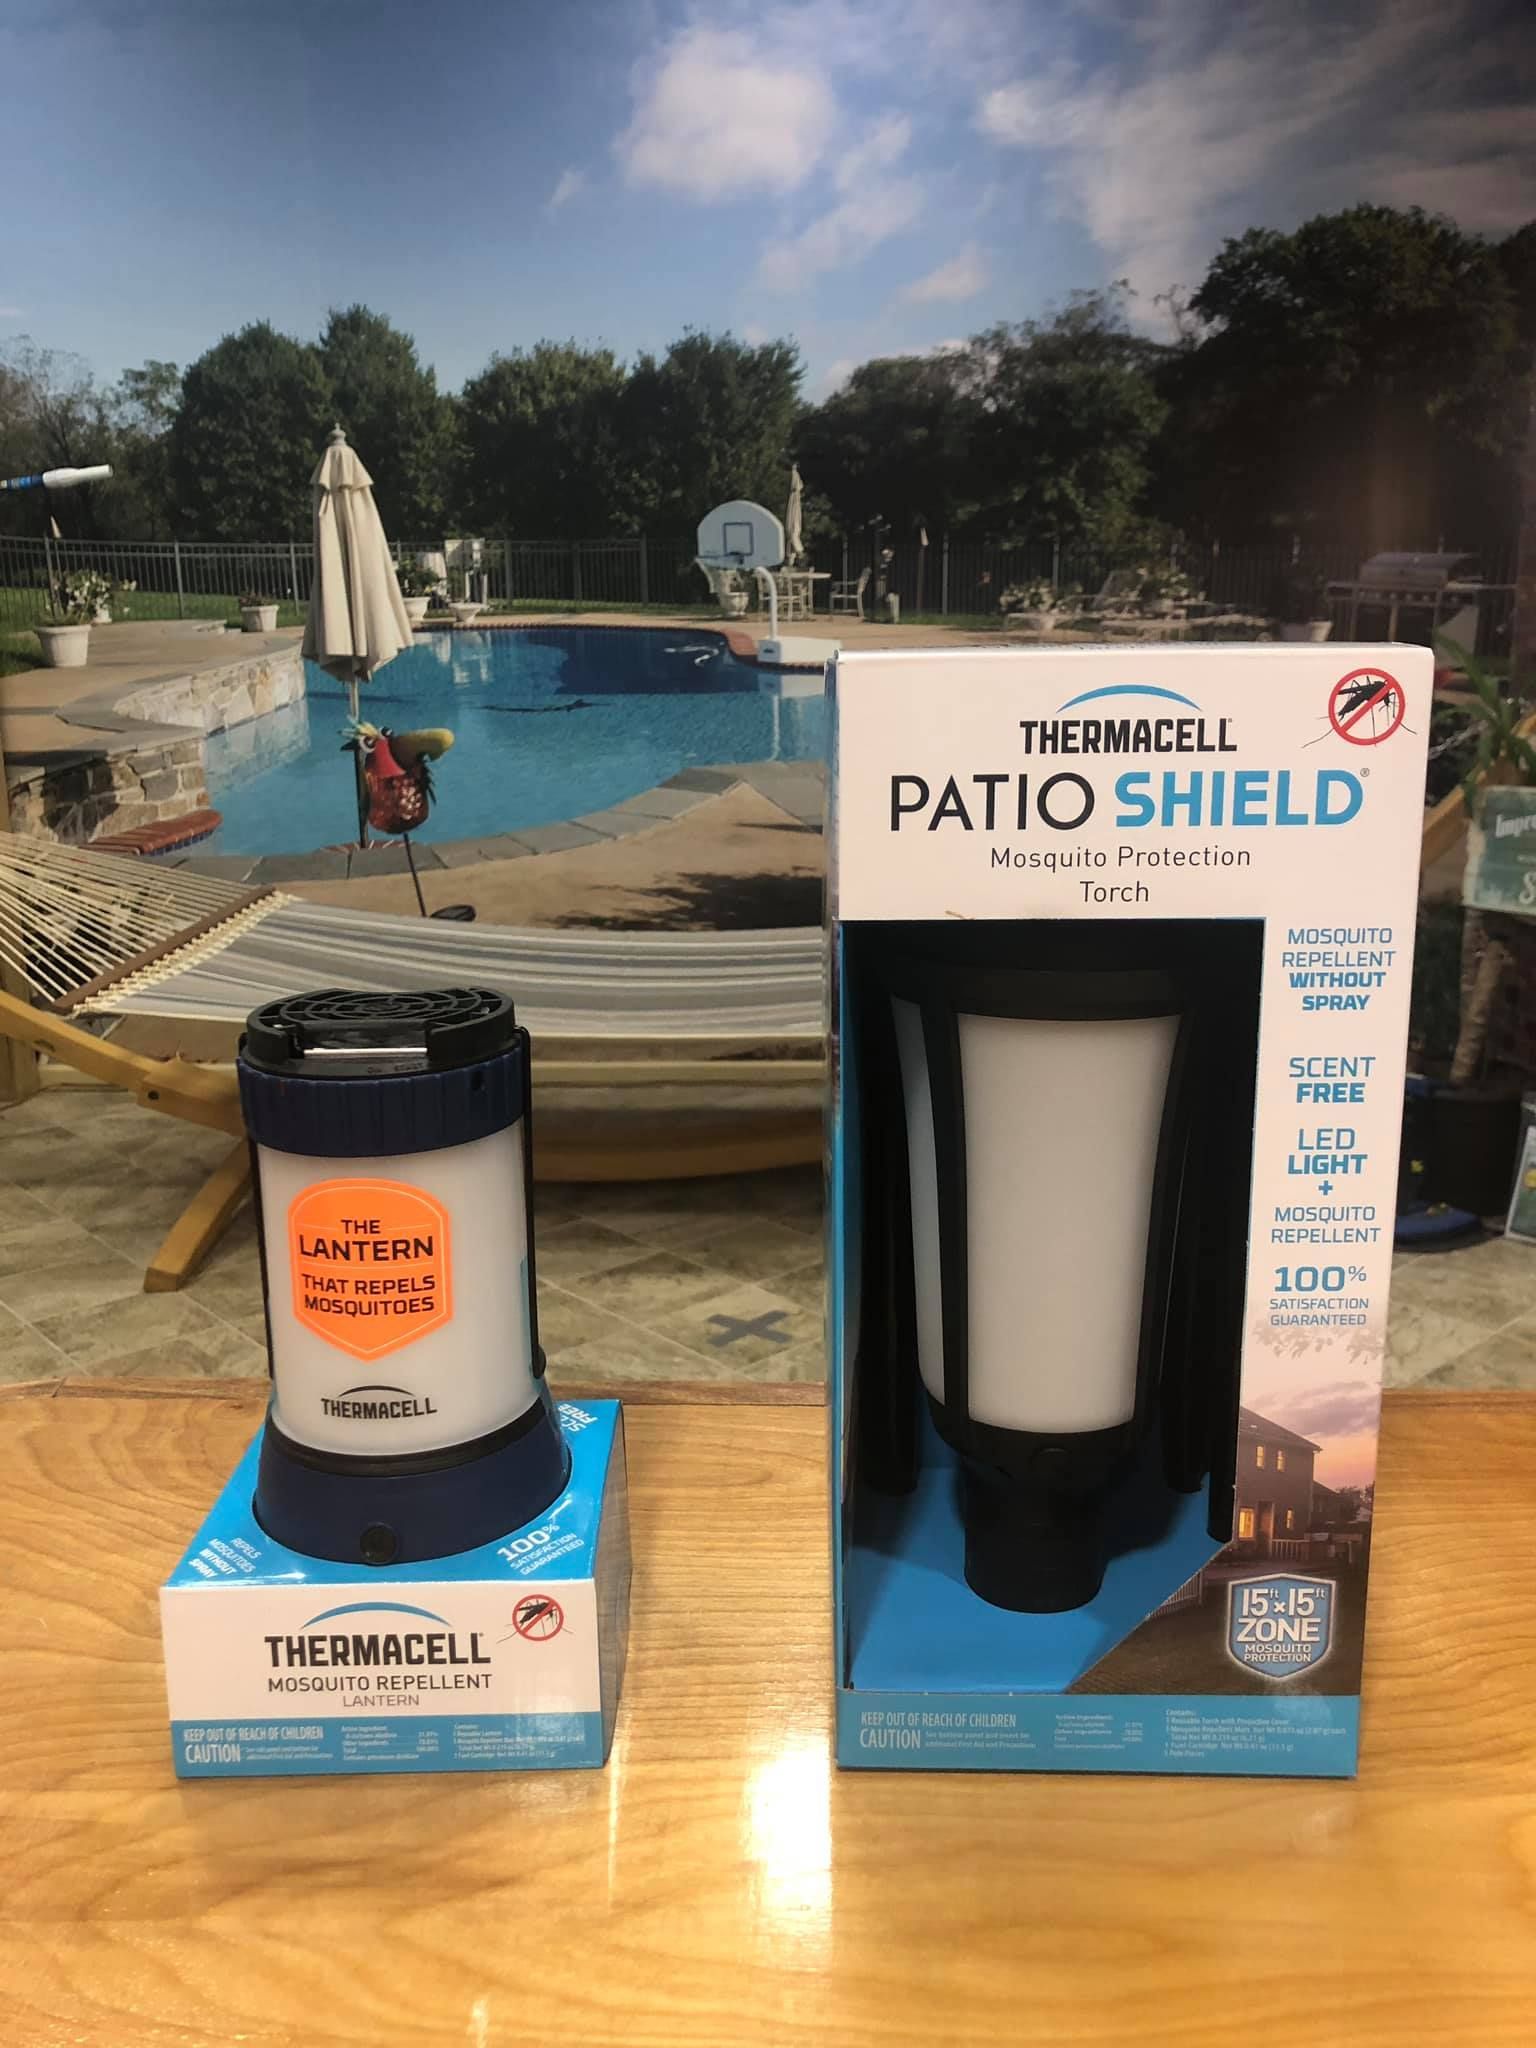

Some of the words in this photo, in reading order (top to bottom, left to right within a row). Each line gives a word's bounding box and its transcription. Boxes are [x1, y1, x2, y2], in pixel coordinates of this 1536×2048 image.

[1020, 718, 1237, 753] THERMACELL
[891, 772, 1095, 831] PATIO
[991, 847, 1106, 871] Mosquito
[1117, 846, 1250, 868] Protection
[1080, 881, 1149, 902] Torch
[1288, 928, 1393, 945] MOSQUITO
[1282, 951, 1396, 967] REPELLENT
[1289, 972, 1386, 988] WITHOUT
[1302, 995, 1370, 1010] SPRAY
[1289, 1057, 1376, 1078] SCENT
[1296, 1083, 1365, 1103] FREE
[1299, 1128, 1354, 1150] LED
[1288, 1155, 1368, 1174] LIGHT
[1275, 1207, 1375, 1222] MOSQUITO
[341, 1219, 381, 1234] THE
[1271, 1228, 1381, 1243] REPELLENT
[300, 1235, 434, 1261] LANTERN
[301, 1273, 349, 1294] THAT
[355, 1275, 436, 1295] REPELS
[1274, 1266, 1367, 1292] 100%
[305, 1295, 435, 1318] MOSQUITOES
[1270, 1298, 1369, 1309] SATISFACTION
[1271, 1314, 1366, 1326] GUARANTEED
[321, 1397, 438, 1419] THERMACELL
[497, 1524, 560, 1562] 100%
[520, 1539, 585, 1575] GUARANTEED
[1237, 1618, 1321, 1642] ZONE
[264, 1633, 491, 1667] THERMACELL
[1244, 1653, 1312, 1662] PROTECTION
[1245, 1643, 1312, 1653] MOSQUITO
[268, 1676, 370, 1692] MOSQUITO
[377, 1674, 492, 1690] REPELLENT
[343, 1694, 420, 1707] LANTERN
[862, 1712, 884, 1726] KEEP
[886, 1712, 905, 1726] OUT
[908, 1712, 920, 1726] OF
[922, 1713, 952, 1727] REACH
[955, 1713, 967, 1727] OF
[969, 1713, 1016, 1728] CHILDREN
[184, 1728, 204, 1742] KEEP
[207, 1728, 224, 1742] OUT
[281, 1726, 323, 1740] CHILDREN
[860, 1729, 921, 1749] CAUTION
[185, 1744, 241, 1763] CAUTION
